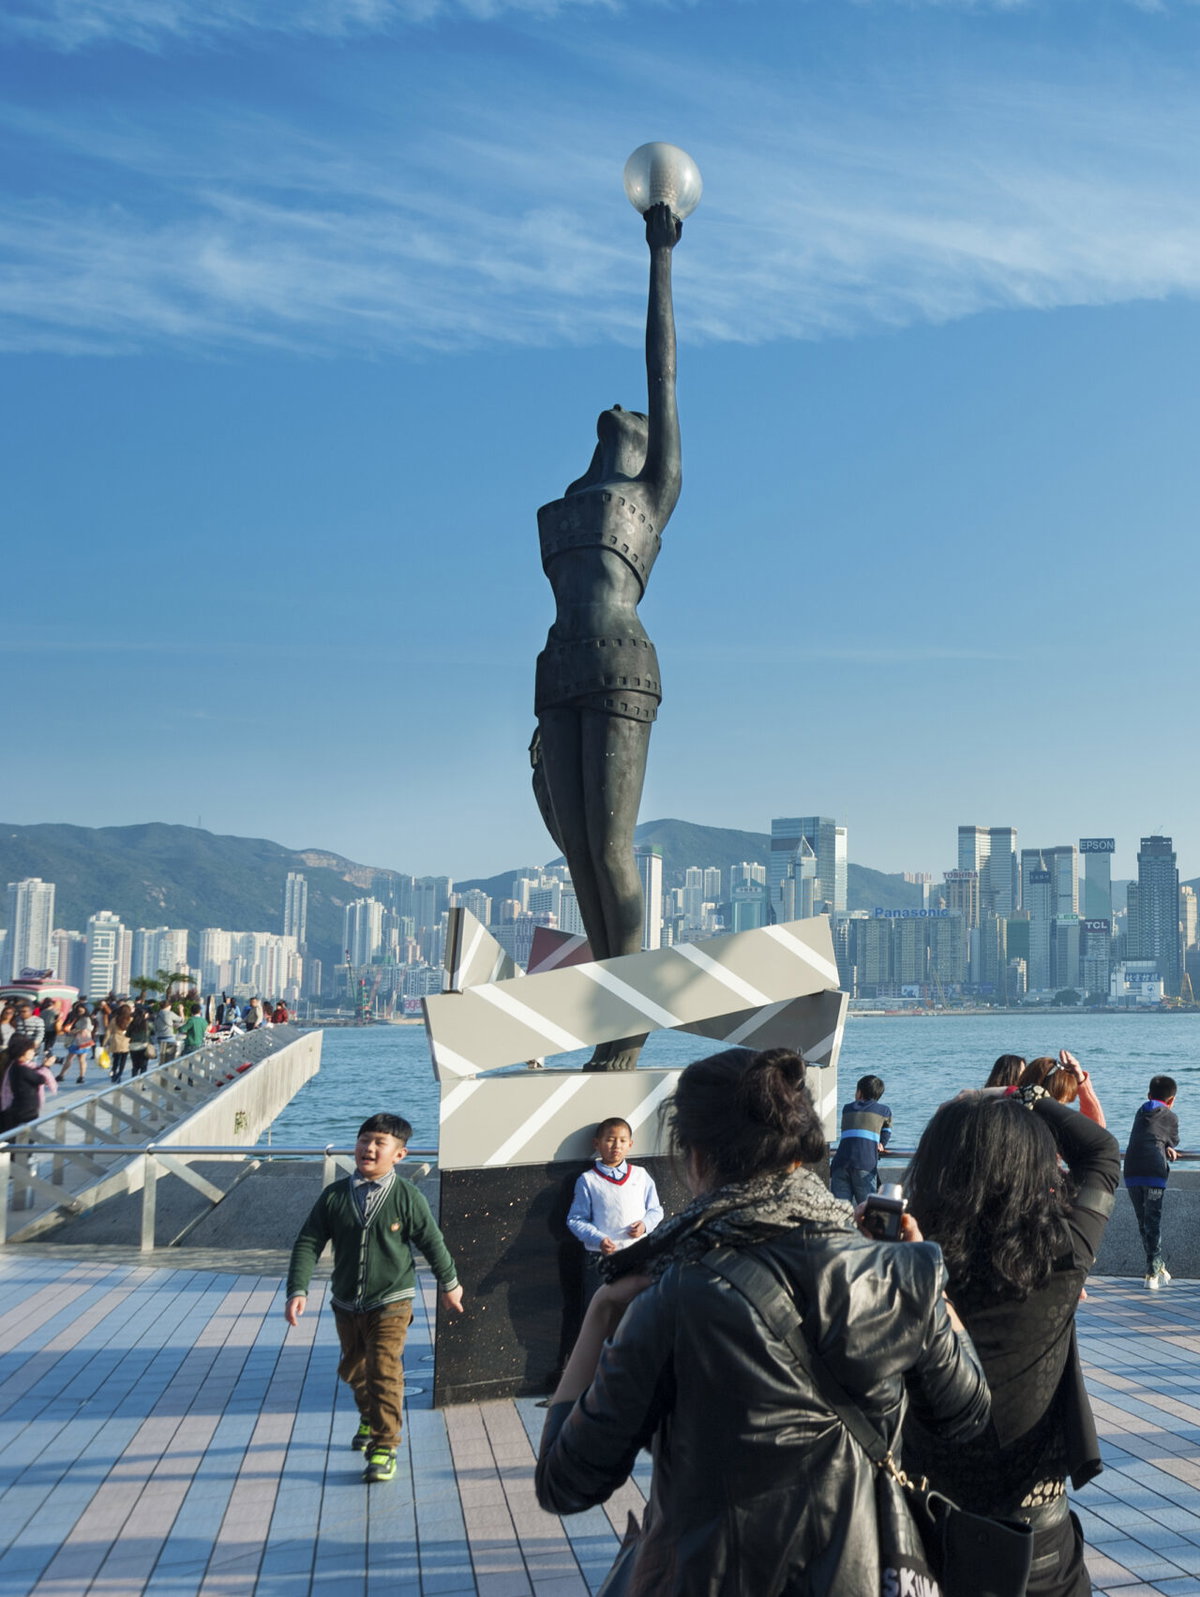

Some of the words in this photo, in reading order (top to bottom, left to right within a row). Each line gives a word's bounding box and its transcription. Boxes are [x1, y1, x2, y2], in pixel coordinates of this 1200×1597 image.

[1080, 841, 1114, 850] EPSON
[875, 908, 949, 917] Panasonic
[1085, 921, 1108, 929] TCL
